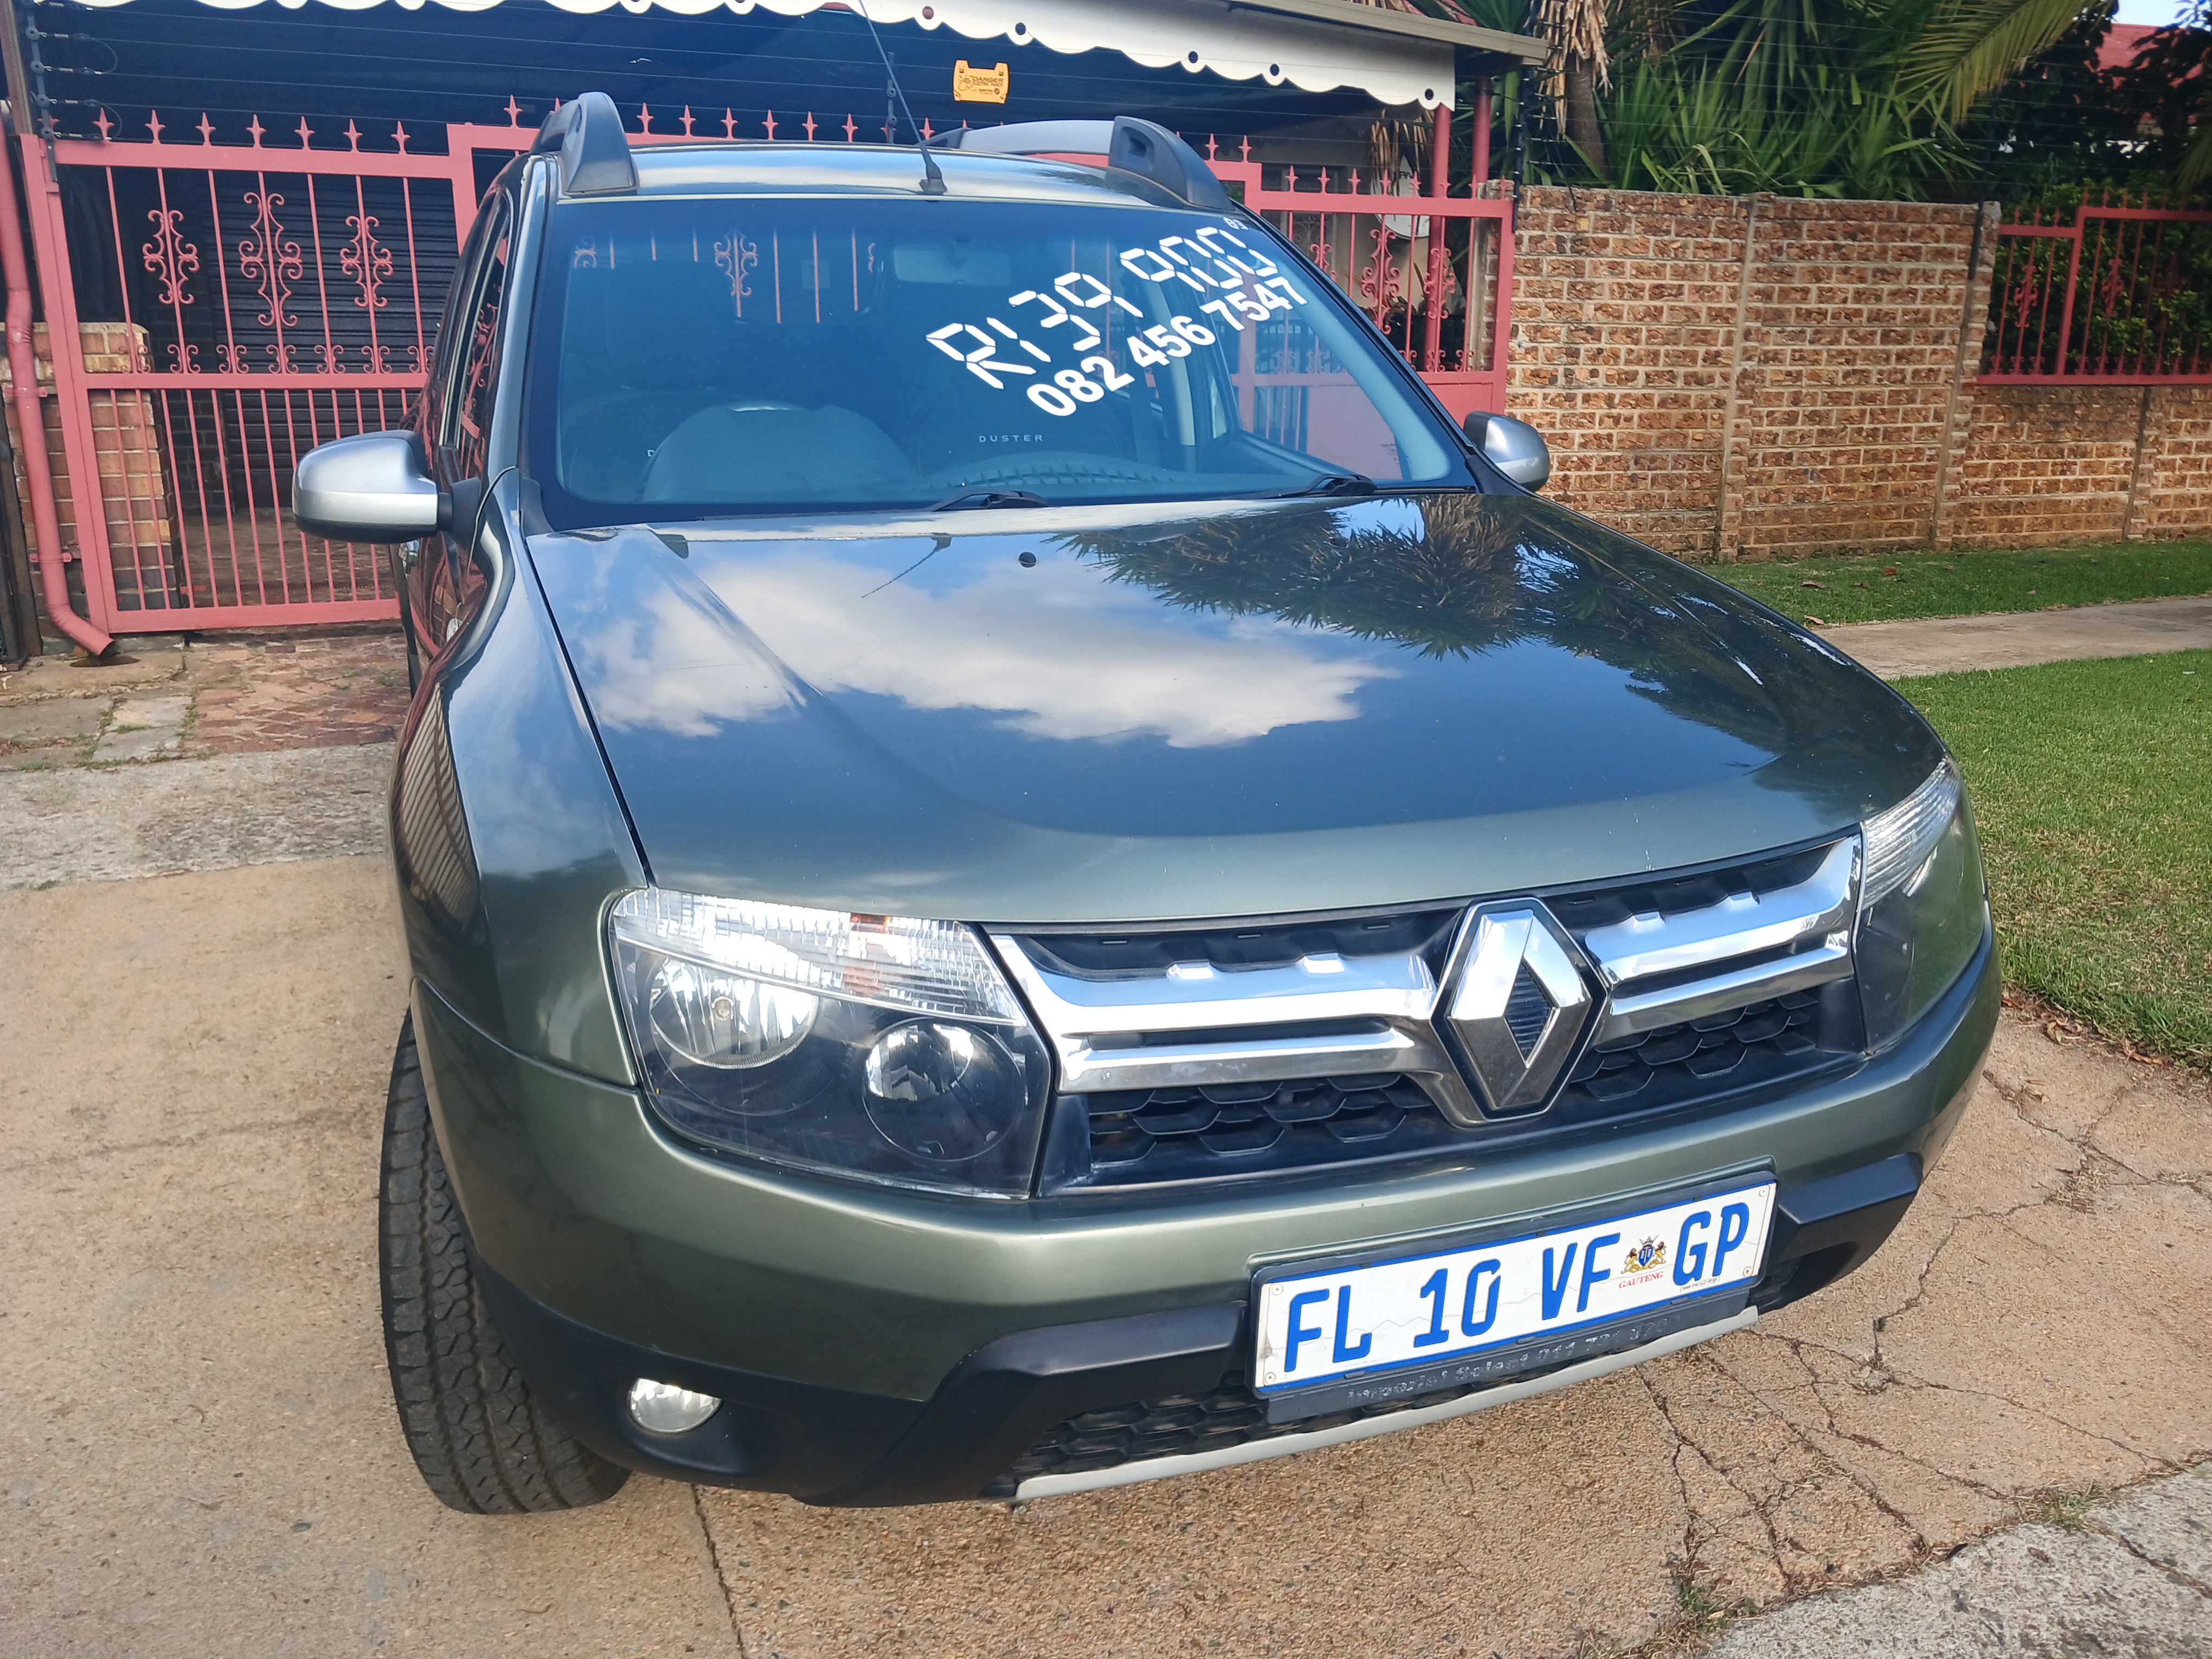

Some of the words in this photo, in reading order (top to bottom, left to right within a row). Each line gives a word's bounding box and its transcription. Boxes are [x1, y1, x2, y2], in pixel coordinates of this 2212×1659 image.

[972, 76, 1004, 84] DANGER
[925, 272, 1143, 389] R139
[1120, 226, 1278, 293] 900
[1026, 356, 1135, 416] 082
[1127, 315, 1216, 368] 456
[1199, 276, 1308, 331] 7547
[979, 434, 1043, 443] DUSTER
[1284, 1285, 1373, 1373] FL
[1413, 1258, 1502, 1348] 10
[1542, 1233, 1621, 1321] VF
[1673, 1201, 1750, 1286] GP
[1618, 1271, 1664, 1289] GAUTENG
